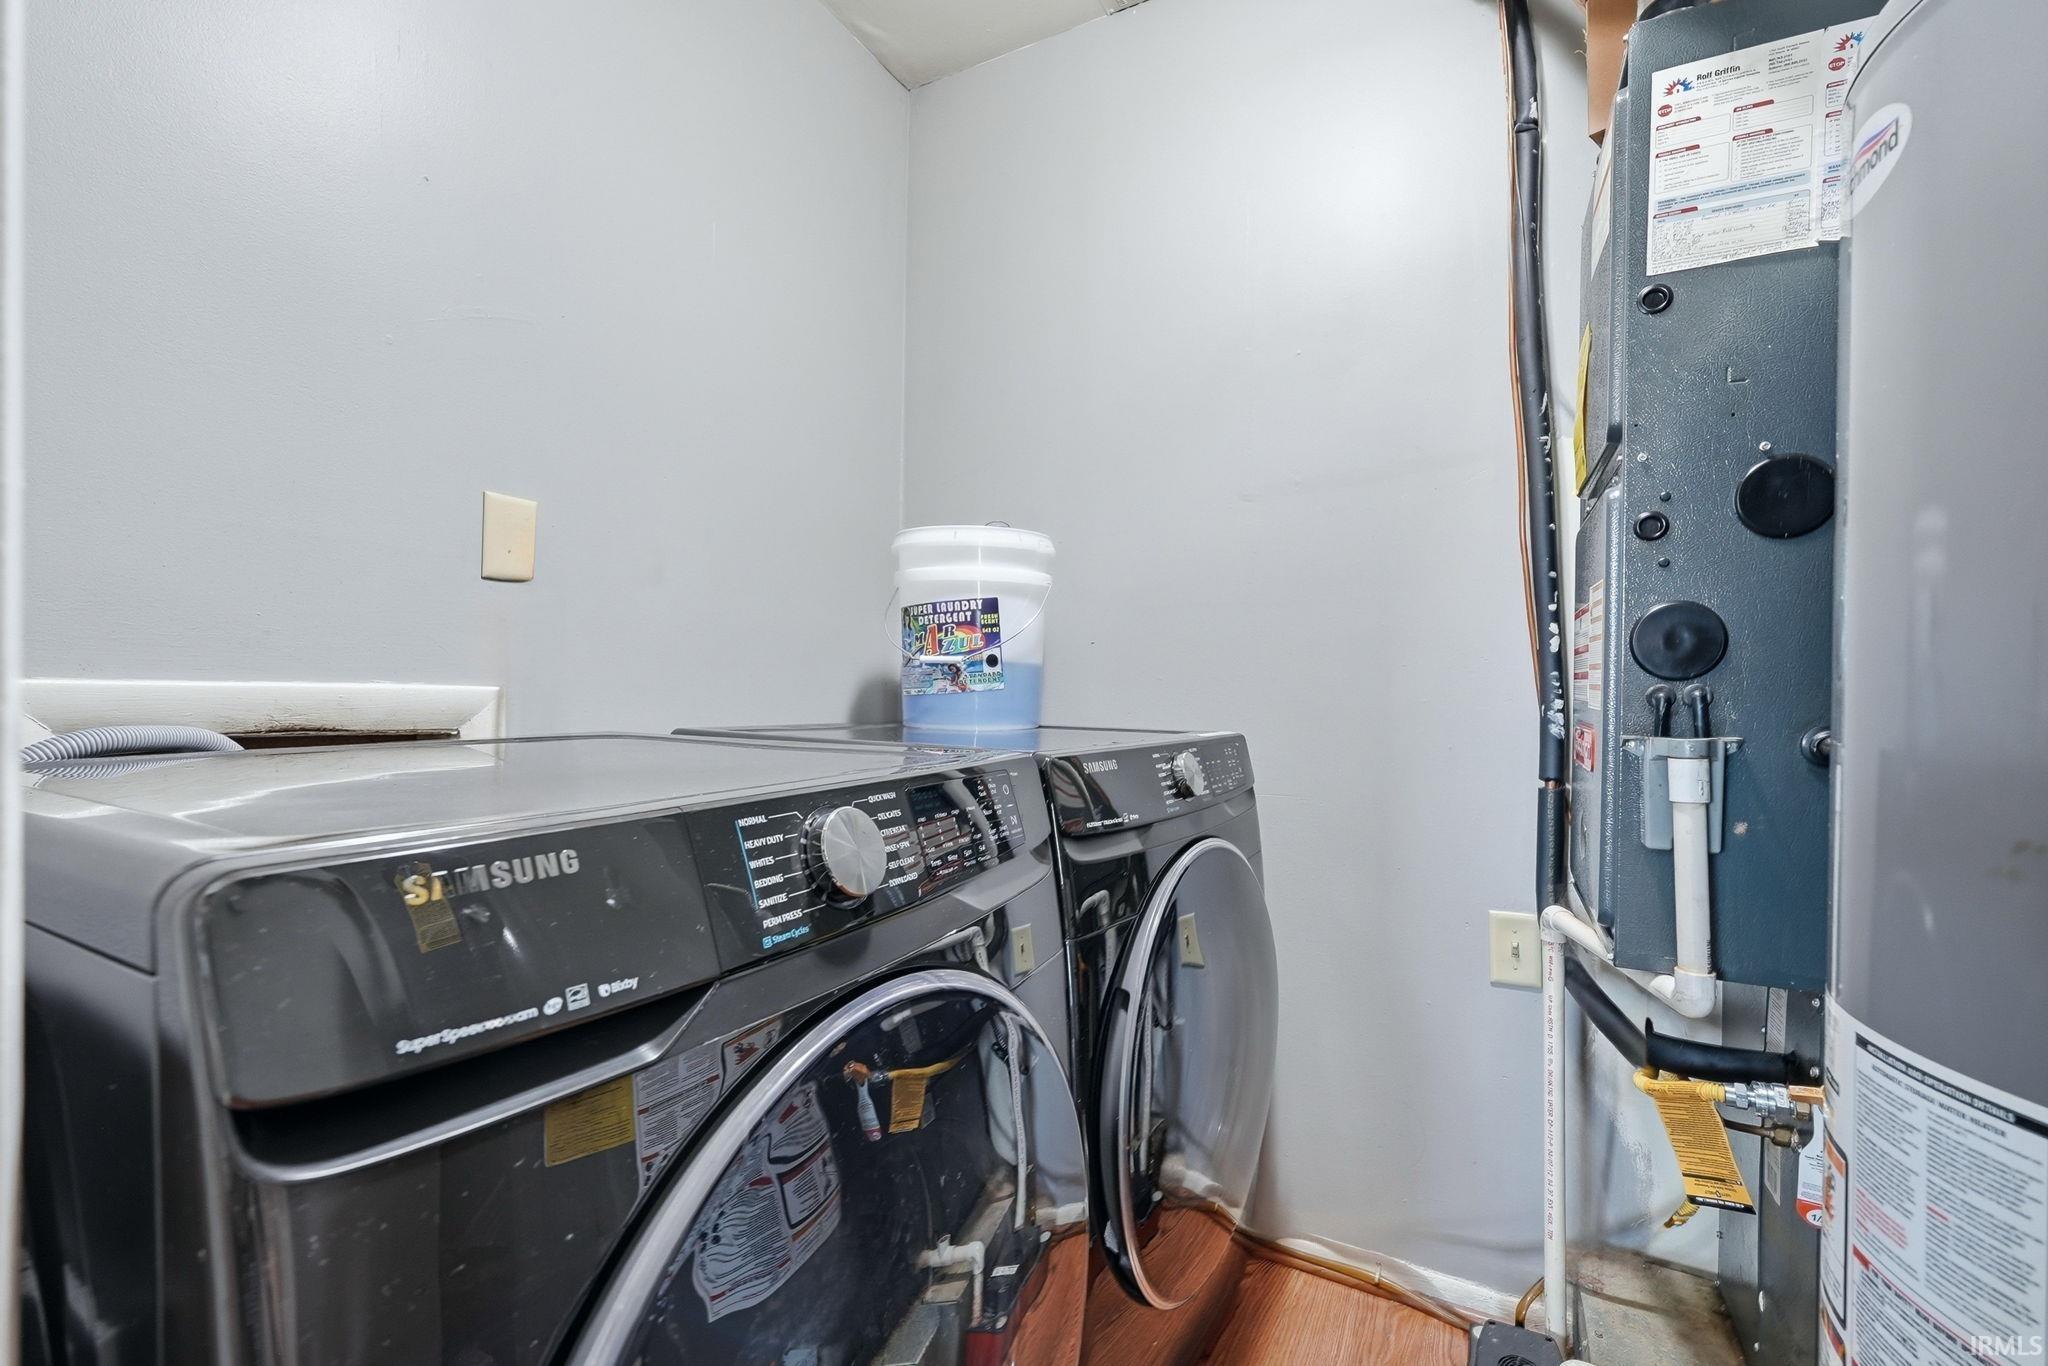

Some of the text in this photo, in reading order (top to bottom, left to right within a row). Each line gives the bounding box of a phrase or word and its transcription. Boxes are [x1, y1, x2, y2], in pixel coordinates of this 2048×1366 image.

[1696, 66, 1741, 80] Rolf Griffin
[936, 600, 984, 612] LAUNDRY
[918, 612, 972, 625] DETERGENT
[1082, 759, 1118, 774] SAMSUNG
[738, 814, 768, 827] NORMAL
[744, 834, 784, 850] HEAVY DUTY
[749, 856, 775, 869] WHITES
[402, 849, 580, 906] SAMSUNG
[754, 874, 784, 888] BEDDING
[758, 892, 788, 908] SANITIZE
[762, 908, 803, 929] PERM PRESS
